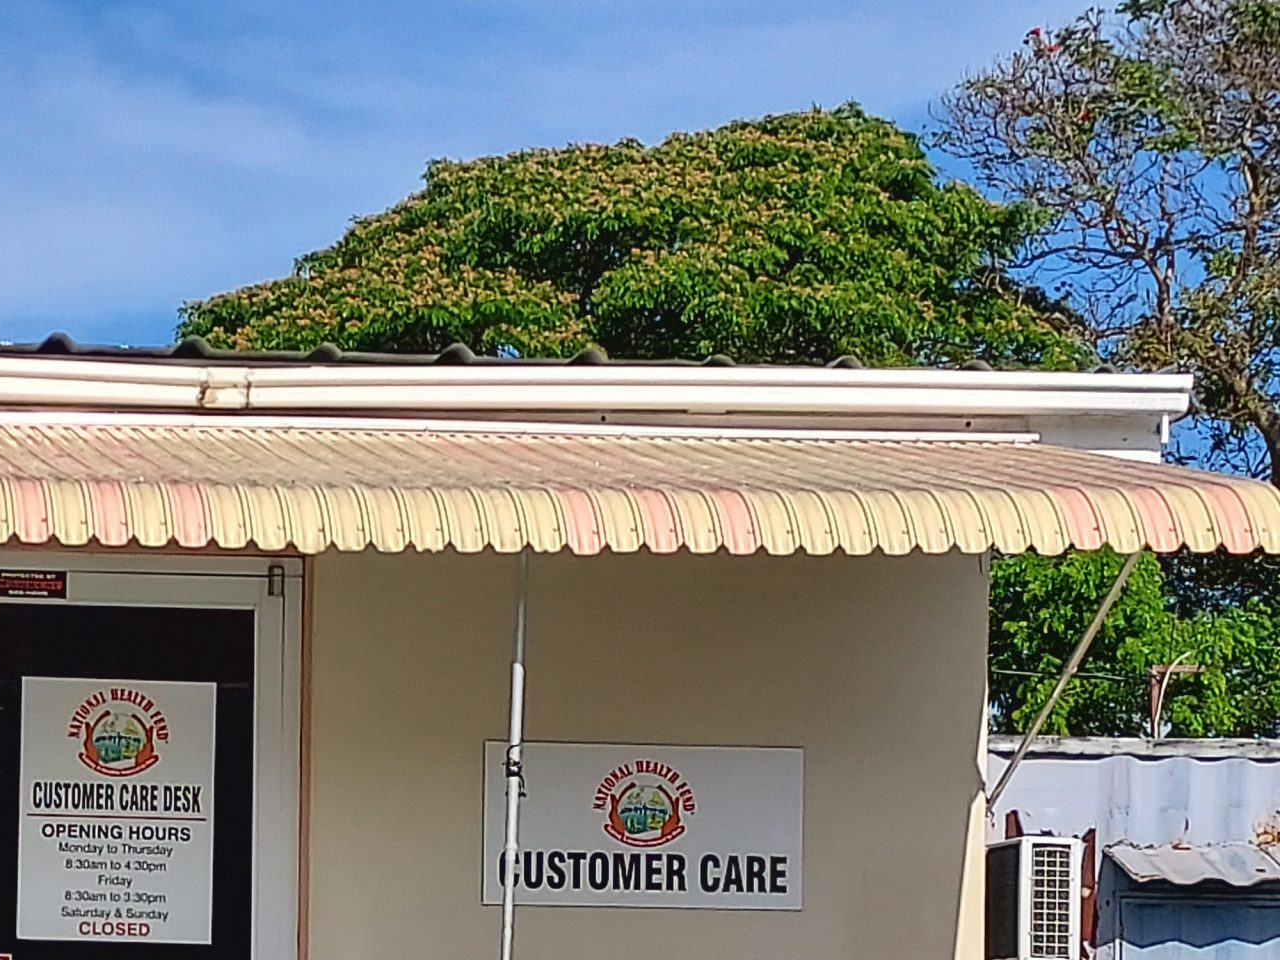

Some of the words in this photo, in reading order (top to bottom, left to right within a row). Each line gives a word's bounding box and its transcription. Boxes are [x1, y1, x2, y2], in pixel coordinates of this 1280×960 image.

[67, 691, 107, 738] NATIONAL
[110, 688, 154, 713] HEALTH
[150, 710, 168, 740] FUND
[593, 763, 634, 810] NATIONAL
[635, 760, 680, 785] HEALTH
[676, 781, 696, 812] FUND
[33, 781, 115, 811] CUSTOMER
[119, 783, 159, 812] CARE
[163, 785, 202, 813] DESK
[41, 823, 123, 840] OPENING
[128, 825, 191, 841] HOURS
[58, 841, 104, 856] Monday
[107, 843, 118, 854] to
[121, 843, 174, 858] Thursday
[110, 859, 122, 871] to
[499, 850, 686, 892] CUSTOMER
[699, 853, 788, 894] CARE
[97, 874, 133, 888] Friday
[109, 891, 121, 903] to
[61, 905, 111, 921] Saturday
[114, 907, 123, 919] &
[125, 907, 169, 922] Sunday
[78, 921, 151, 937] CLOSED
